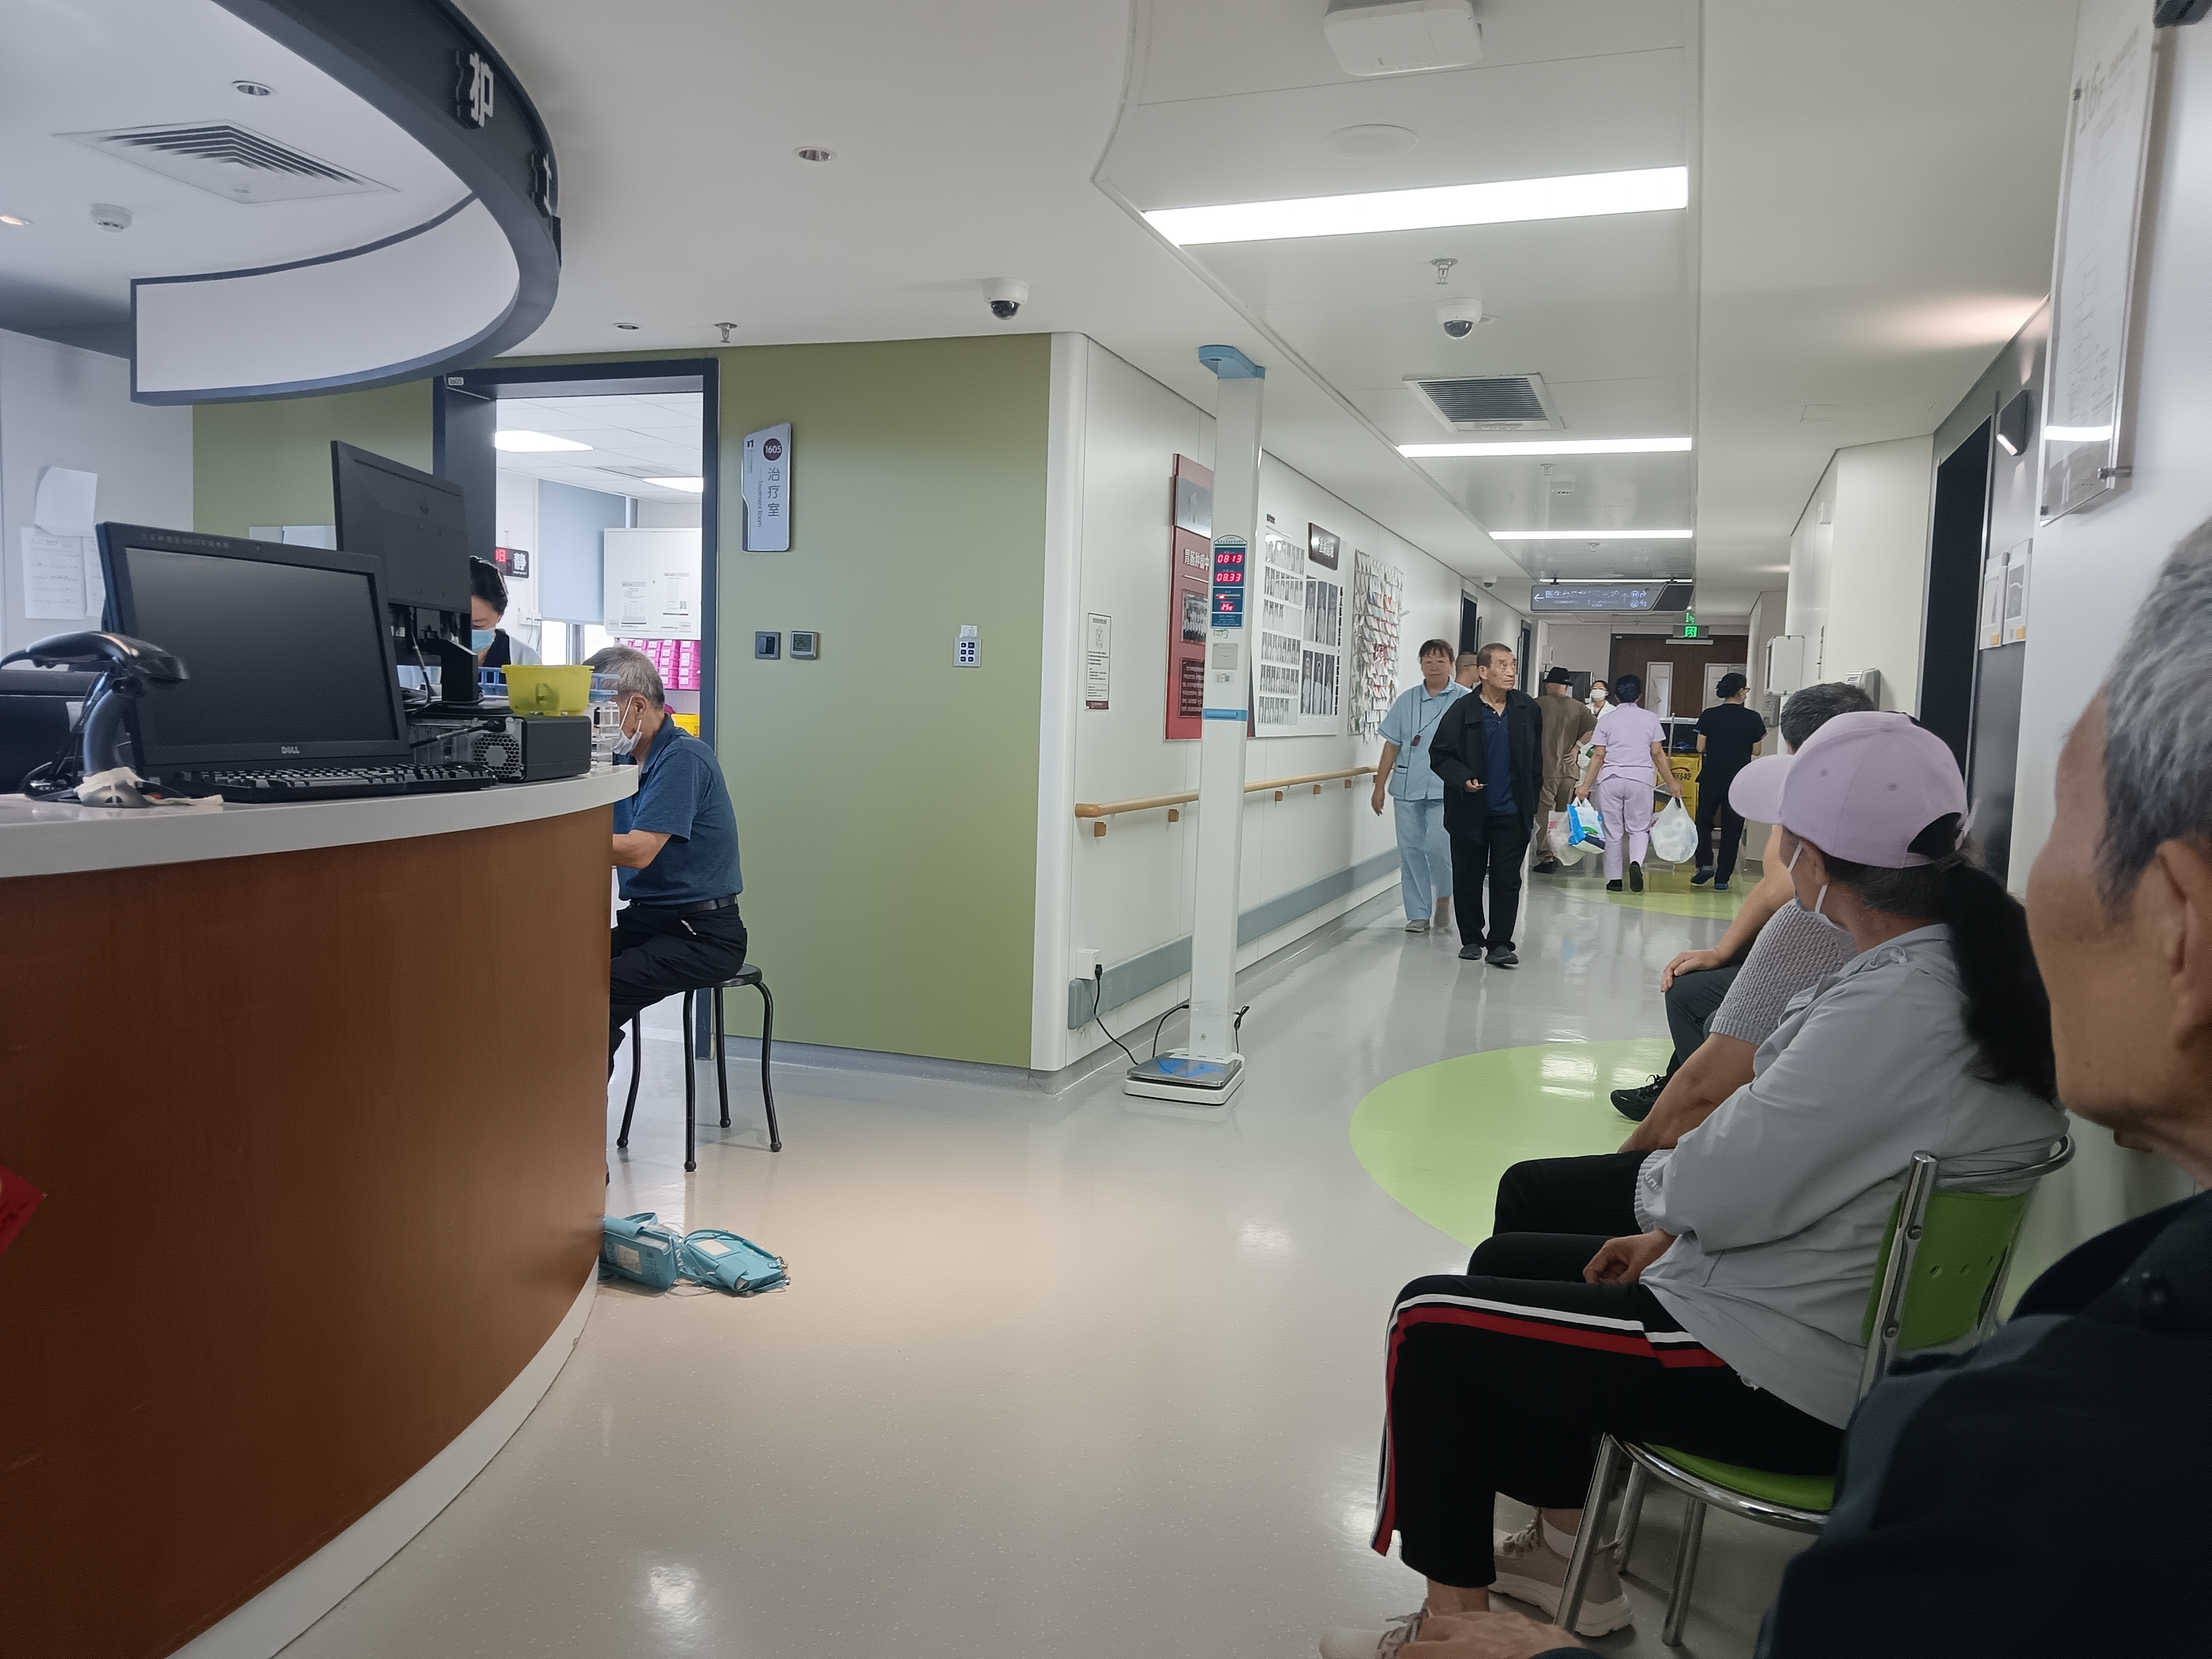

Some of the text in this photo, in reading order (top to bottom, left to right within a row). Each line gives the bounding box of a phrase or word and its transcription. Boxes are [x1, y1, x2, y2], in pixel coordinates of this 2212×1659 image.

[765, 445, 781, 454] 1605
[767, 467, 780, 517] 治疗室
[1216, 573, 1242, 582] 08.33
[281, 746, 300, 754] DELL
